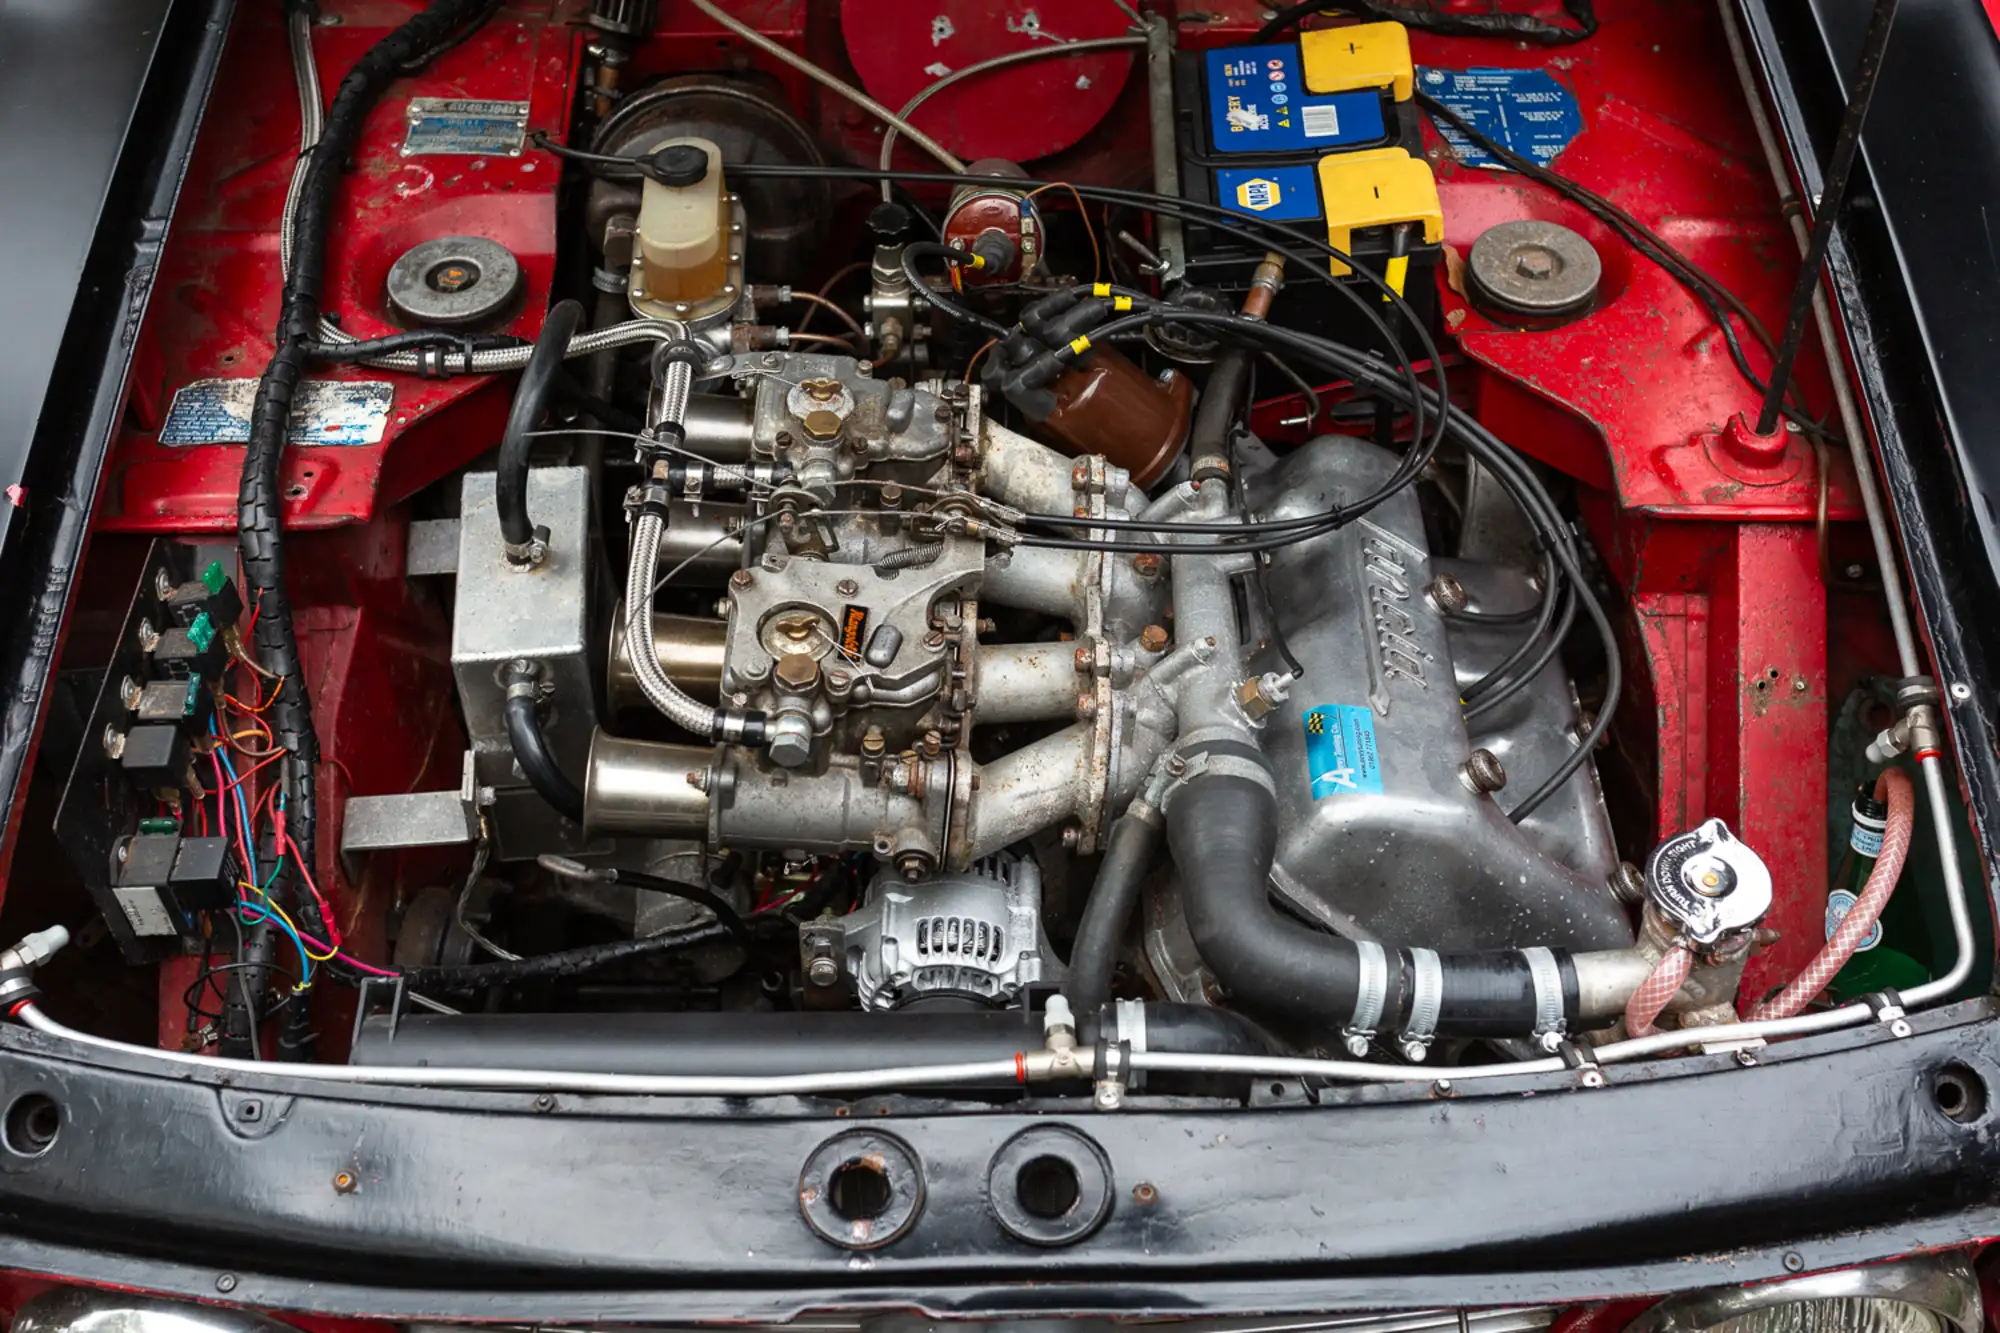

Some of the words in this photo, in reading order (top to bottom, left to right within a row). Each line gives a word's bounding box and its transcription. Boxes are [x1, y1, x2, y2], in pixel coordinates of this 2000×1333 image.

[1230, 95, 1243, 133] BAERY
[1249, 181, 1271, 208] NAPA
[1667, 840, 1697, 860] TIGHT
[1660, 857, 1673, 884] DOWN
[1666, 885, 1690, 911] TURN
